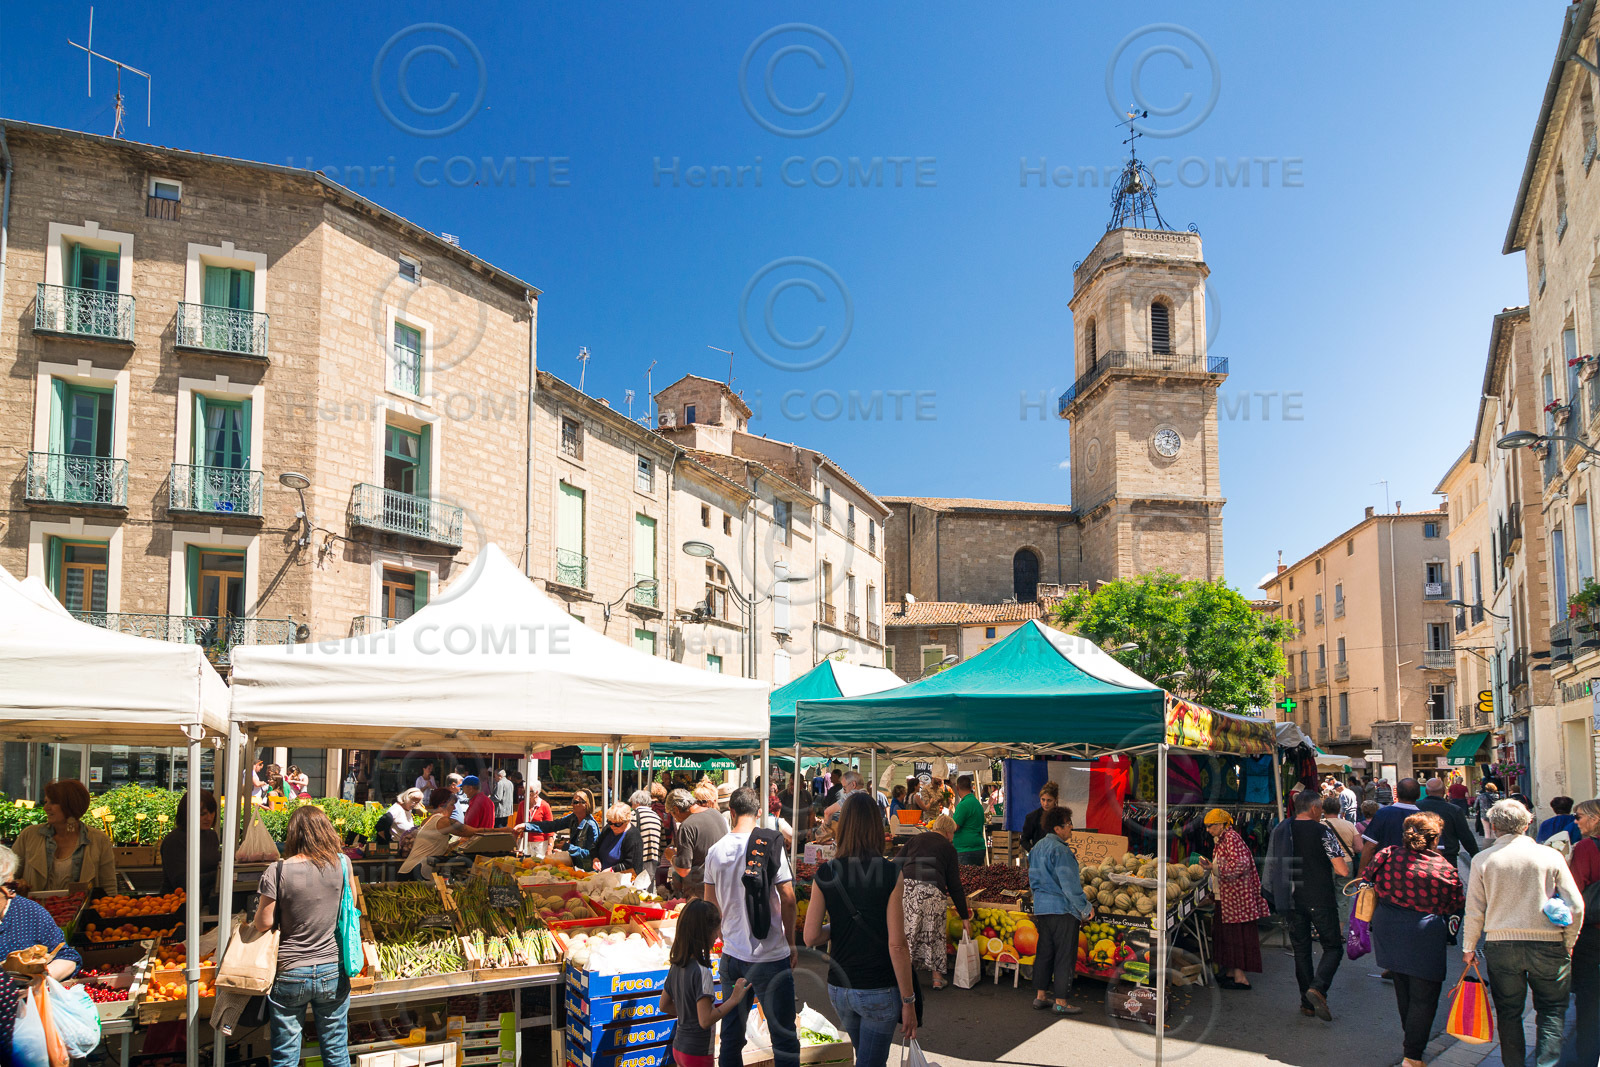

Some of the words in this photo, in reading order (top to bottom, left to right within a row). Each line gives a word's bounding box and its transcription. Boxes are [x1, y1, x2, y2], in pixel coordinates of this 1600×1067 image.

[611, 976, 652, 993] Fruca
[612, 1003, 654, 1020] Fruca
[614, 1029, 656, 1046] Fruca
